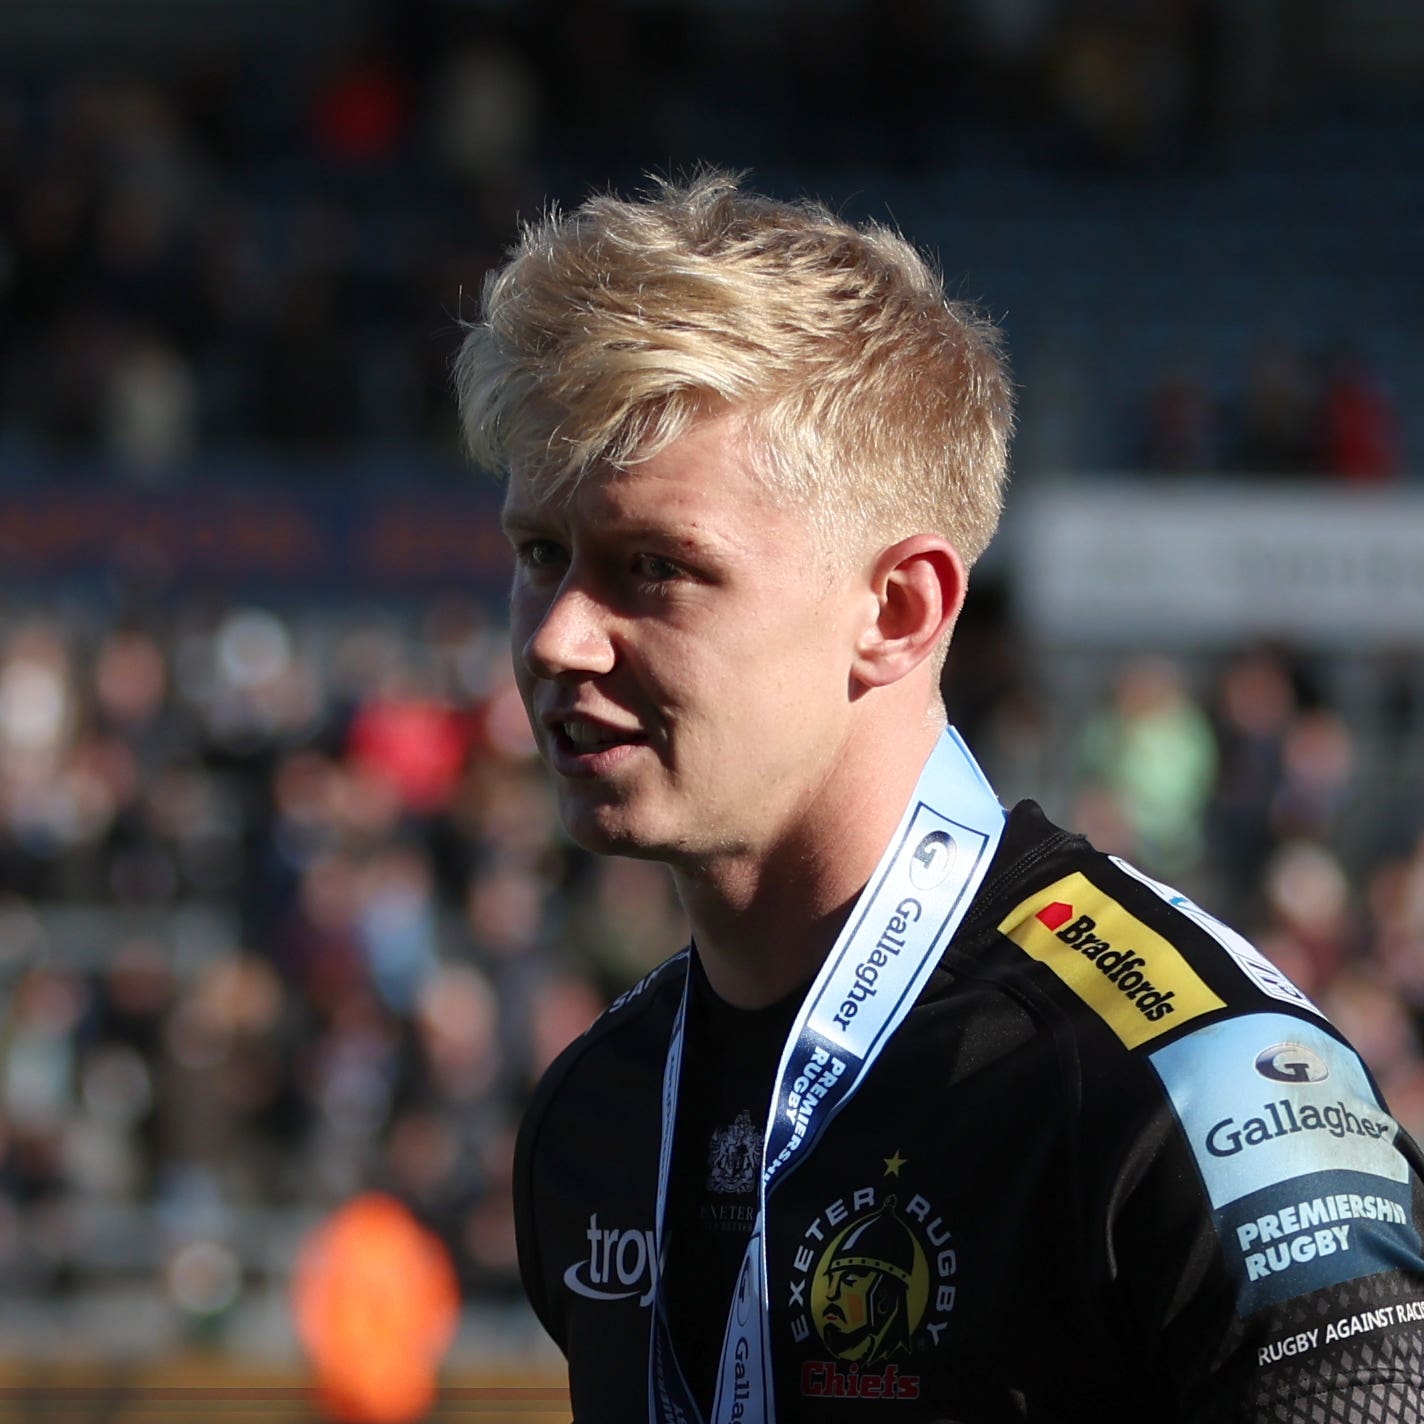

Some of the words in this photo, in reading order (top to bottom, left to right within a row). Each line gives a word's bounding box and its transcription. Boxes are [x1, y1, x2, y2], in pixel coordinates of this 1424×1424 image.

[832, 897, 922, 1032] Gallagher
[1056, 914, 1175, 1021] Bradfords
[763, 1057, 847, 1187] PREMIERSHI
[783, 1045, 830, 1126] RUGBY
[1206, 1100, 1389, 1157] Gallagher
[587, 1211, 672, 1307] troy
[788, 1186, 876, 1344] EXETER
[905, 1193, 957, 1347] RUGBY
[1244, 1224, 1350, 1282] RUGBY
[800, 1360, 920, 1400] Chiefs
[1258, 1329, 1319, 1366] RUGBY
[1325, 1306, 1394, 1344] AGAINST
